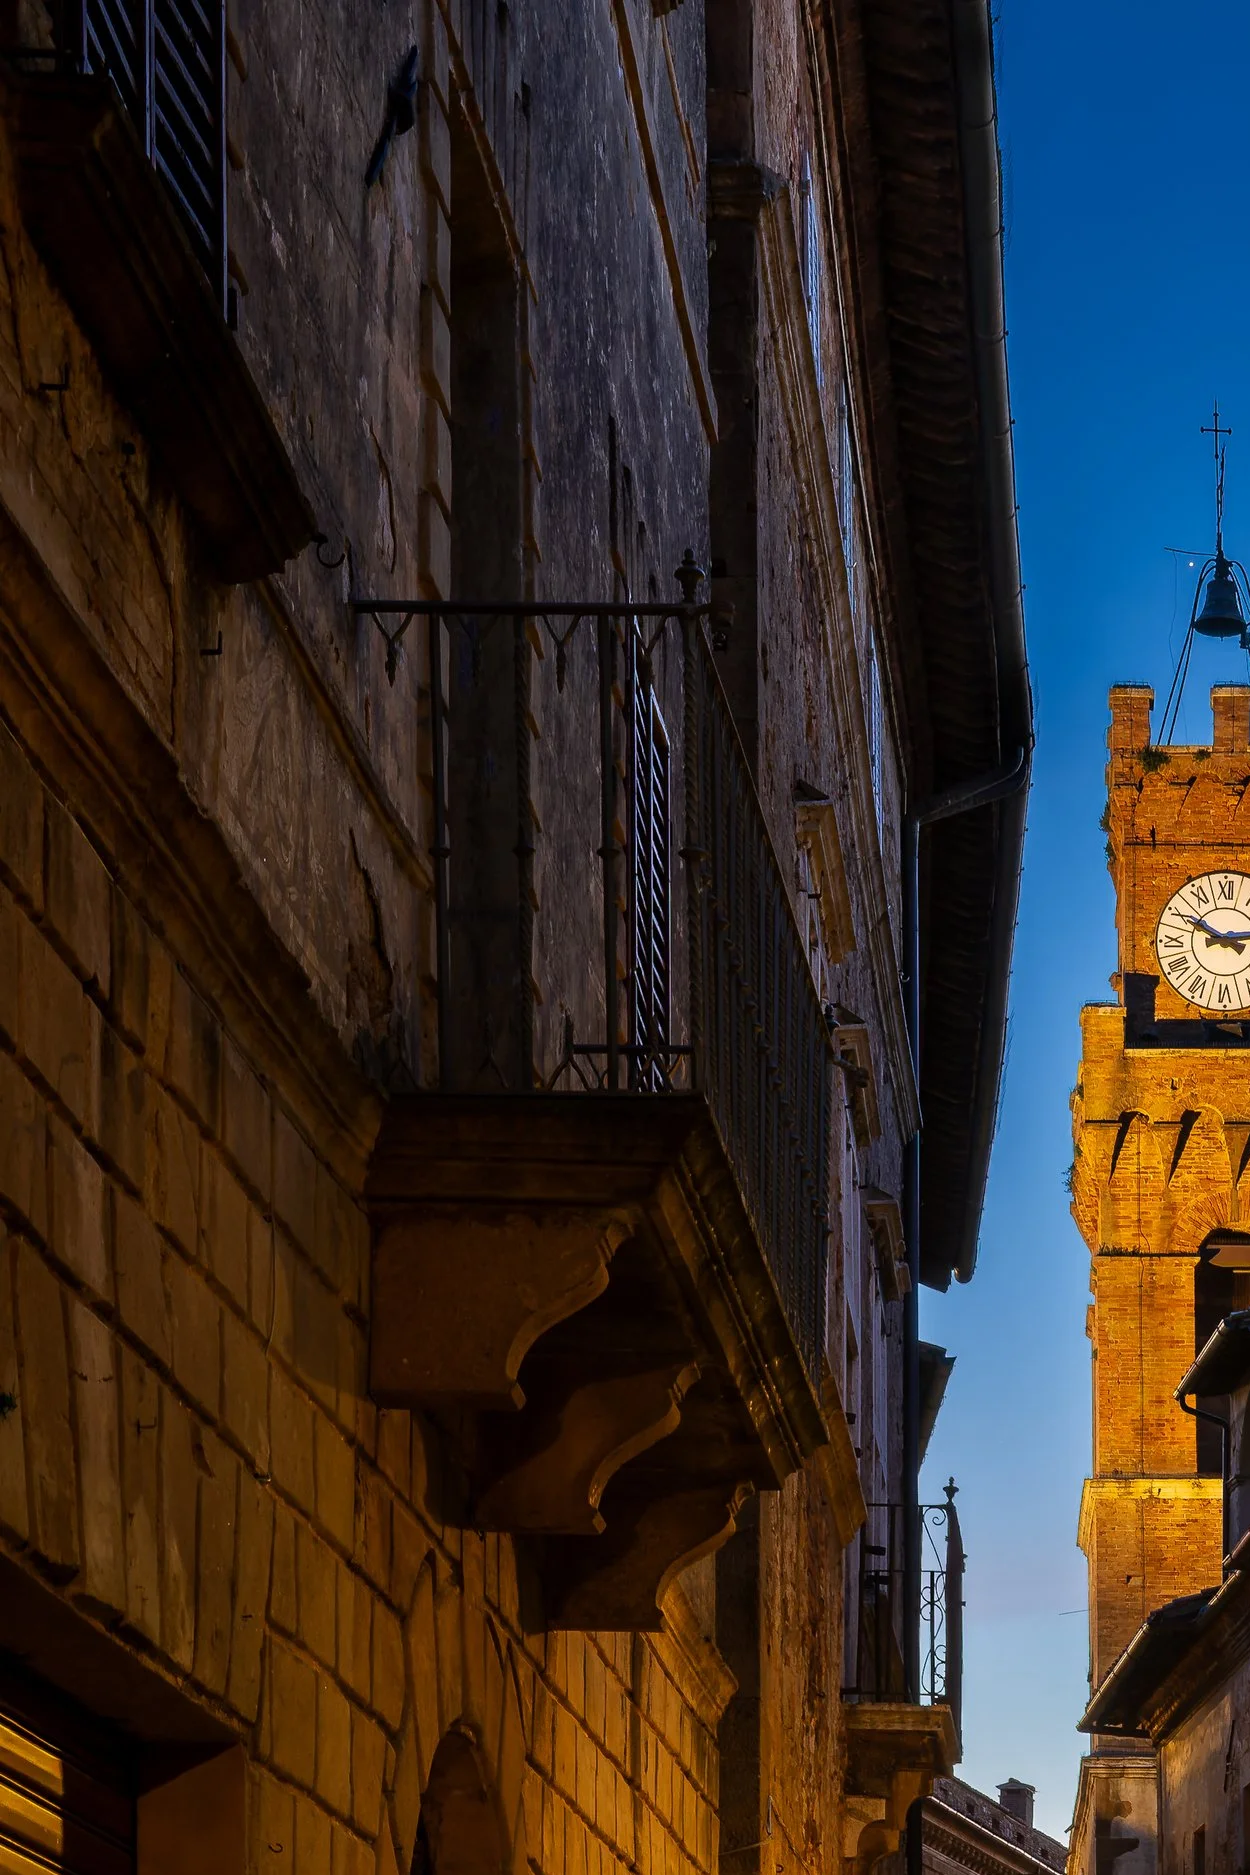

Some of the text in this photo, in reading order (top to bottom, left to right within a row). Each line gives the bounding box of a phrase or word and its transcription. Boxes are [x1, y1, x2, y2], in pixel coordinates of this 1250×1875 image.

[1190, 885, 1210, 909] XI
[1217, 880, 1234, 901] XII
[1170, 906, 1192, 925] X
[1164, 934, 1184, 948] IX
[1168, 955, 1191, 981] VIII
[1188, 975, 1207, 999] VII
[1218, 983, 1232, 1004] VI
